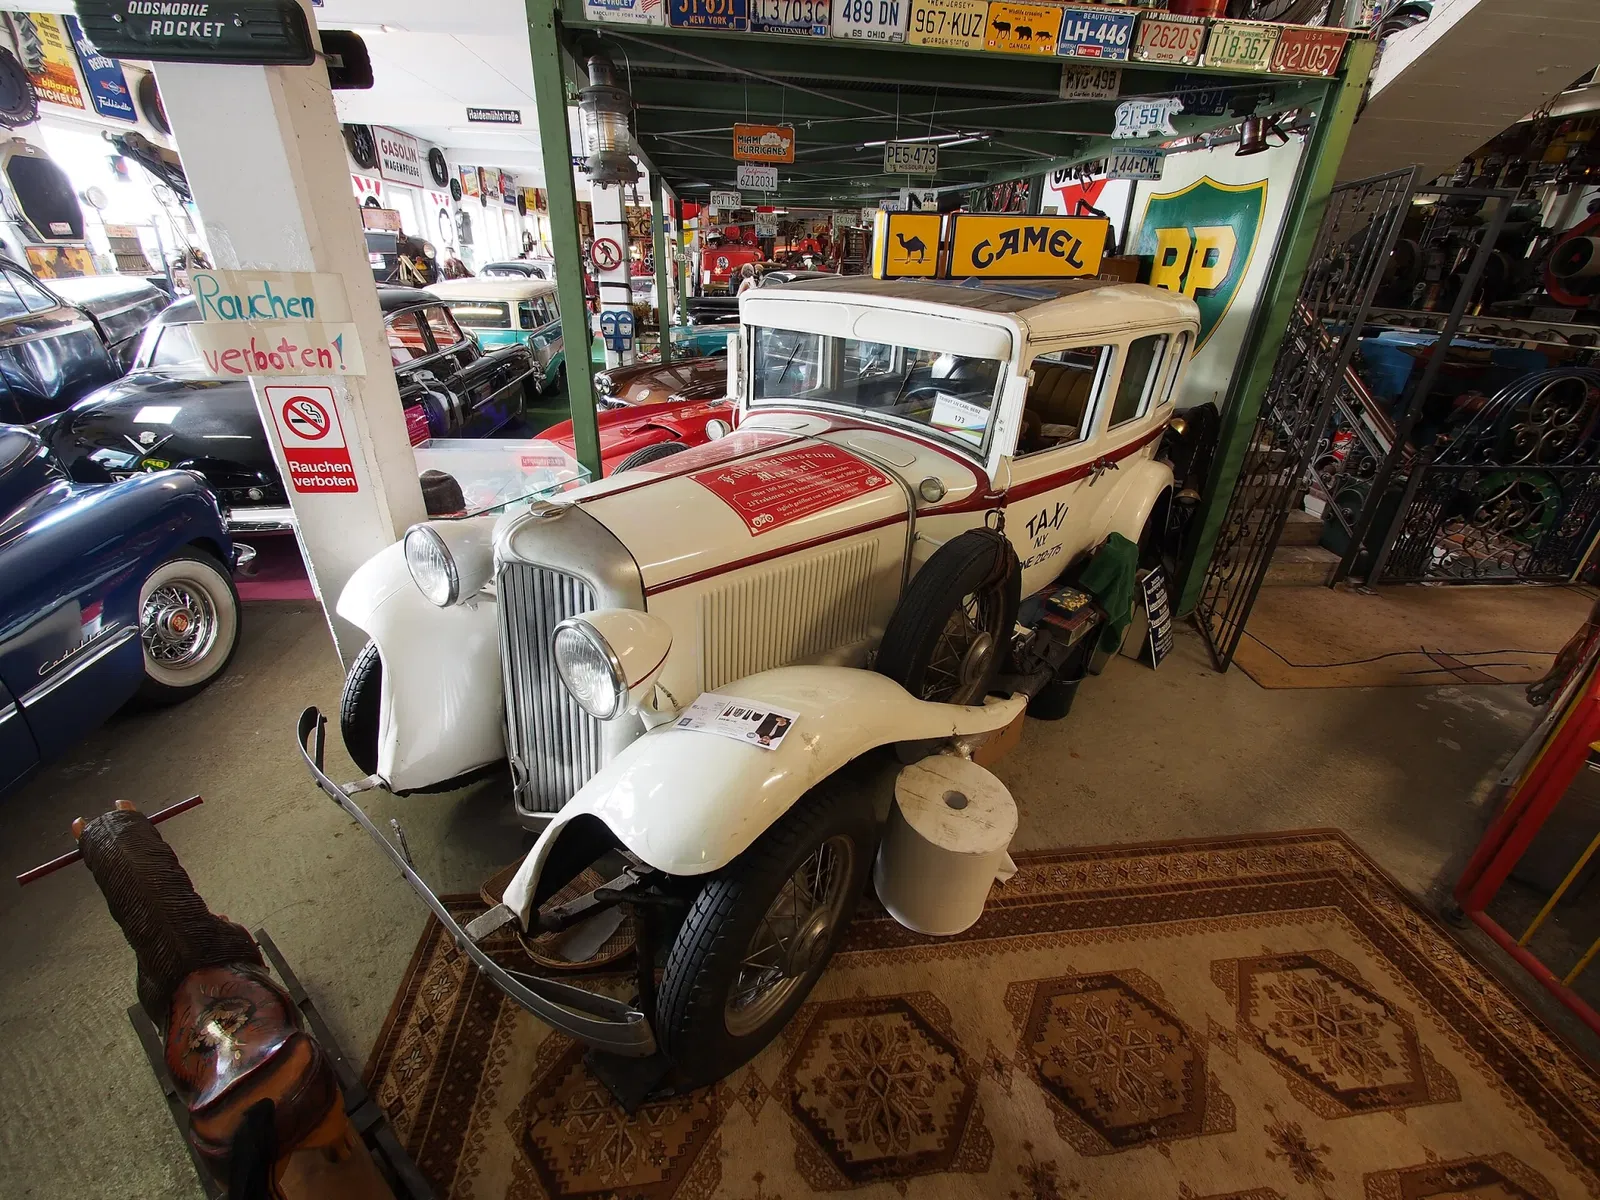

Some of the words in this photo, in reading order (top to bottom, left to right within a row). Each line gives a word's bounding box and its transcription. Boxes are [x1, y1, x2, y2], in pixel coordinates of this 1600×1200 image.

[127, 1, 209, 17] OLDSMOBILE
[842, 0, 873, 24] 489
[878, 1, 899, 26] DN
[1083, 12, 1115, 22] BEAUTIFUL
[689, 15, 706, 24] NEW
[707, 16, 727, 25] YORK
[150, 20, 225, 38] ROCKET
[769, 26, 809, 36] CENTENNIAL
[852, 29, 863, 38] 69
[866, 30, 887, 39] OHIO
[1064, 20, 1129, 46] LH-446
[1149, 24, 1190, 50] 2620
[1304, 33, 1323, 41] USA
[1009, 42, 1032, 50] CANADA
[1156, 52, 1174, 60] OHIO
[34, 86, 83, 107] MICHELIN
[468, 109, 520, 123] Haidemühlstraße
[737, 135, 760, 145] MIAMI
[380, 138, 417, 163] GASOLIN
[737, 146, 787, 156] HURRICANES
[384, 158, 420, 177] WAGENPFLEGE
[971, 226, 1084, 270] CAMEL
[1153, 225, 1238, 299] BP
[192, 274, 316, 322] Rauchen
[202, 332, 347, 374] verboten!
[954, 415, 965, 424] 173
[289, 461, 351, 474] Rauchen
[293, 476, 355, 488] verboten
[1025, 502, 1069, 540] TAXI
[38, 622, 120, 676] Cadillac
